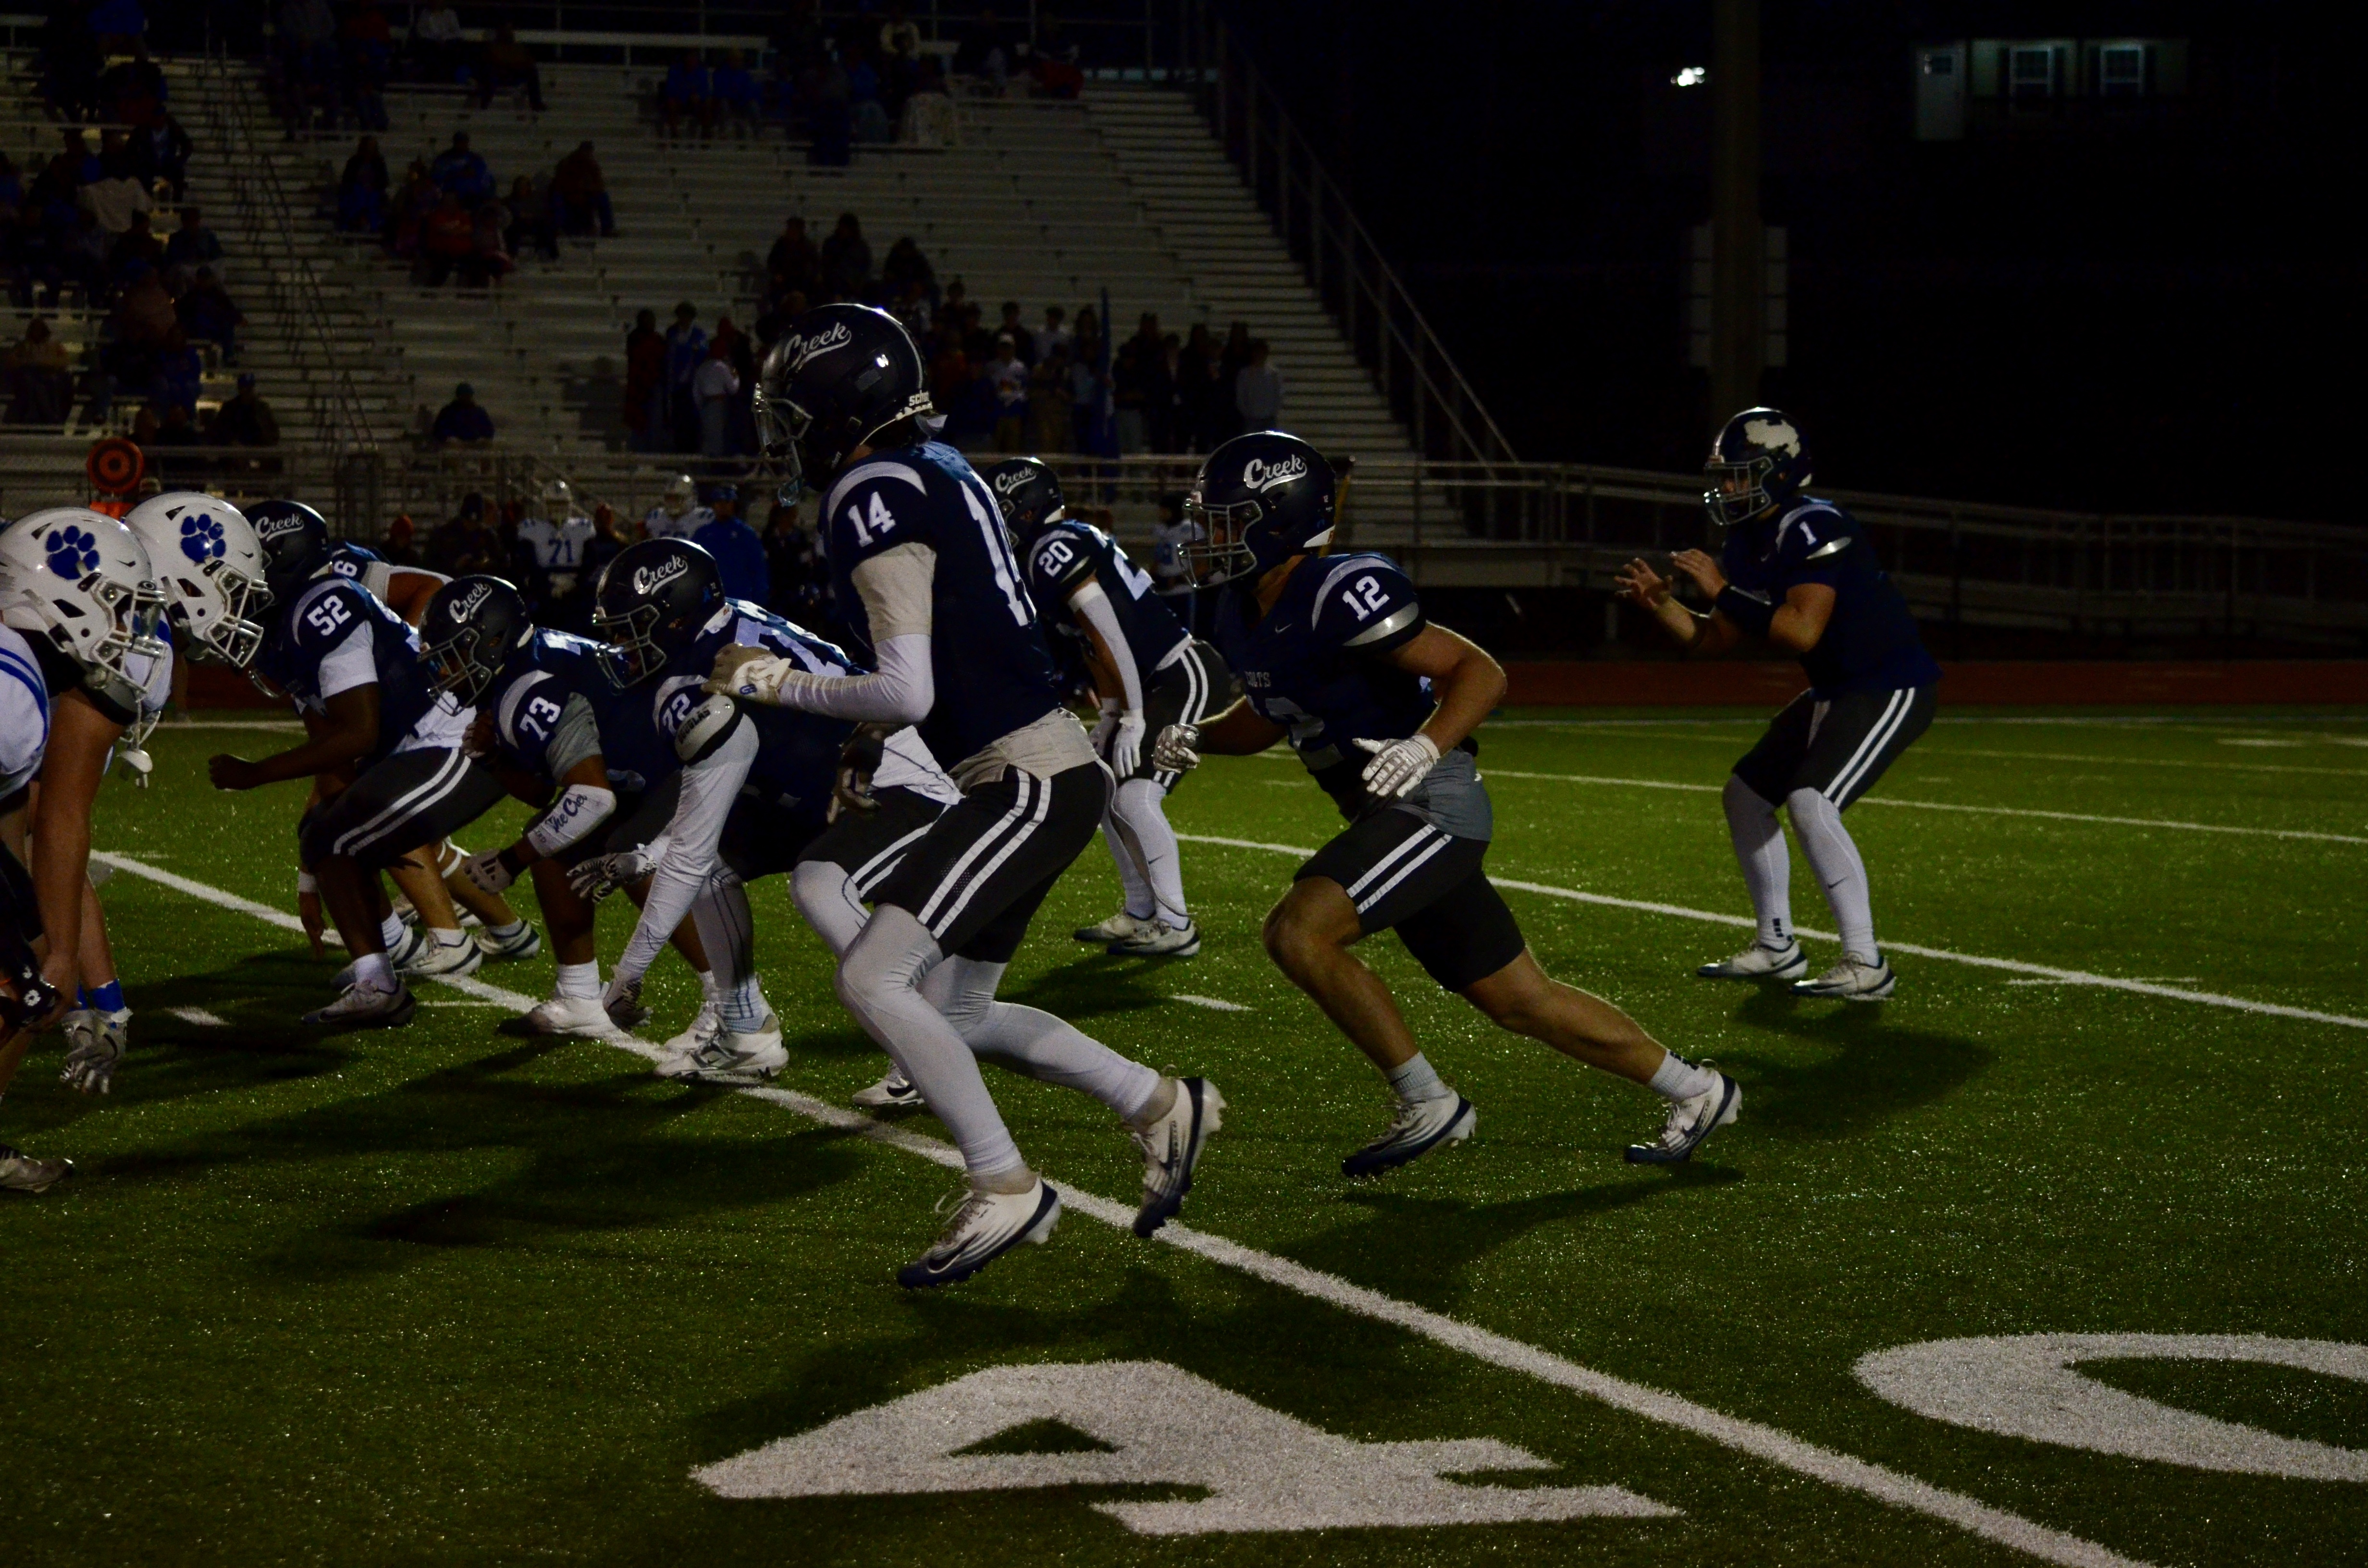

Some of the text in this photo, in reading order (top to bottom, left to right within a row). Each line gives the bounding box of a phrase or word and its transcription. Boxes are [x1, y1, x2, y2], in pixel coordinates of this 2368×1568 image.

[783, 321, 852, 374] Creek
[995, 466, 1037, 495] Creek
[1244, 453, 1307, 493] Creek
[255, 513, 305, 542] Creek
[848, 490, 897, 548] 14
[1799, 520, 1817, 546] 1
[549, 539, 572, 563] 71
[1038, 540, 1074, 577] 20
[633, 554, 688, 596] Creek
[306, 595, 352, 637] 52
[449, 582, 493, 624] Creek
[1342, 576, 1390, 622] 12
[519, 696, 561, 741] 73
[662, 692, 697, 737] 72
